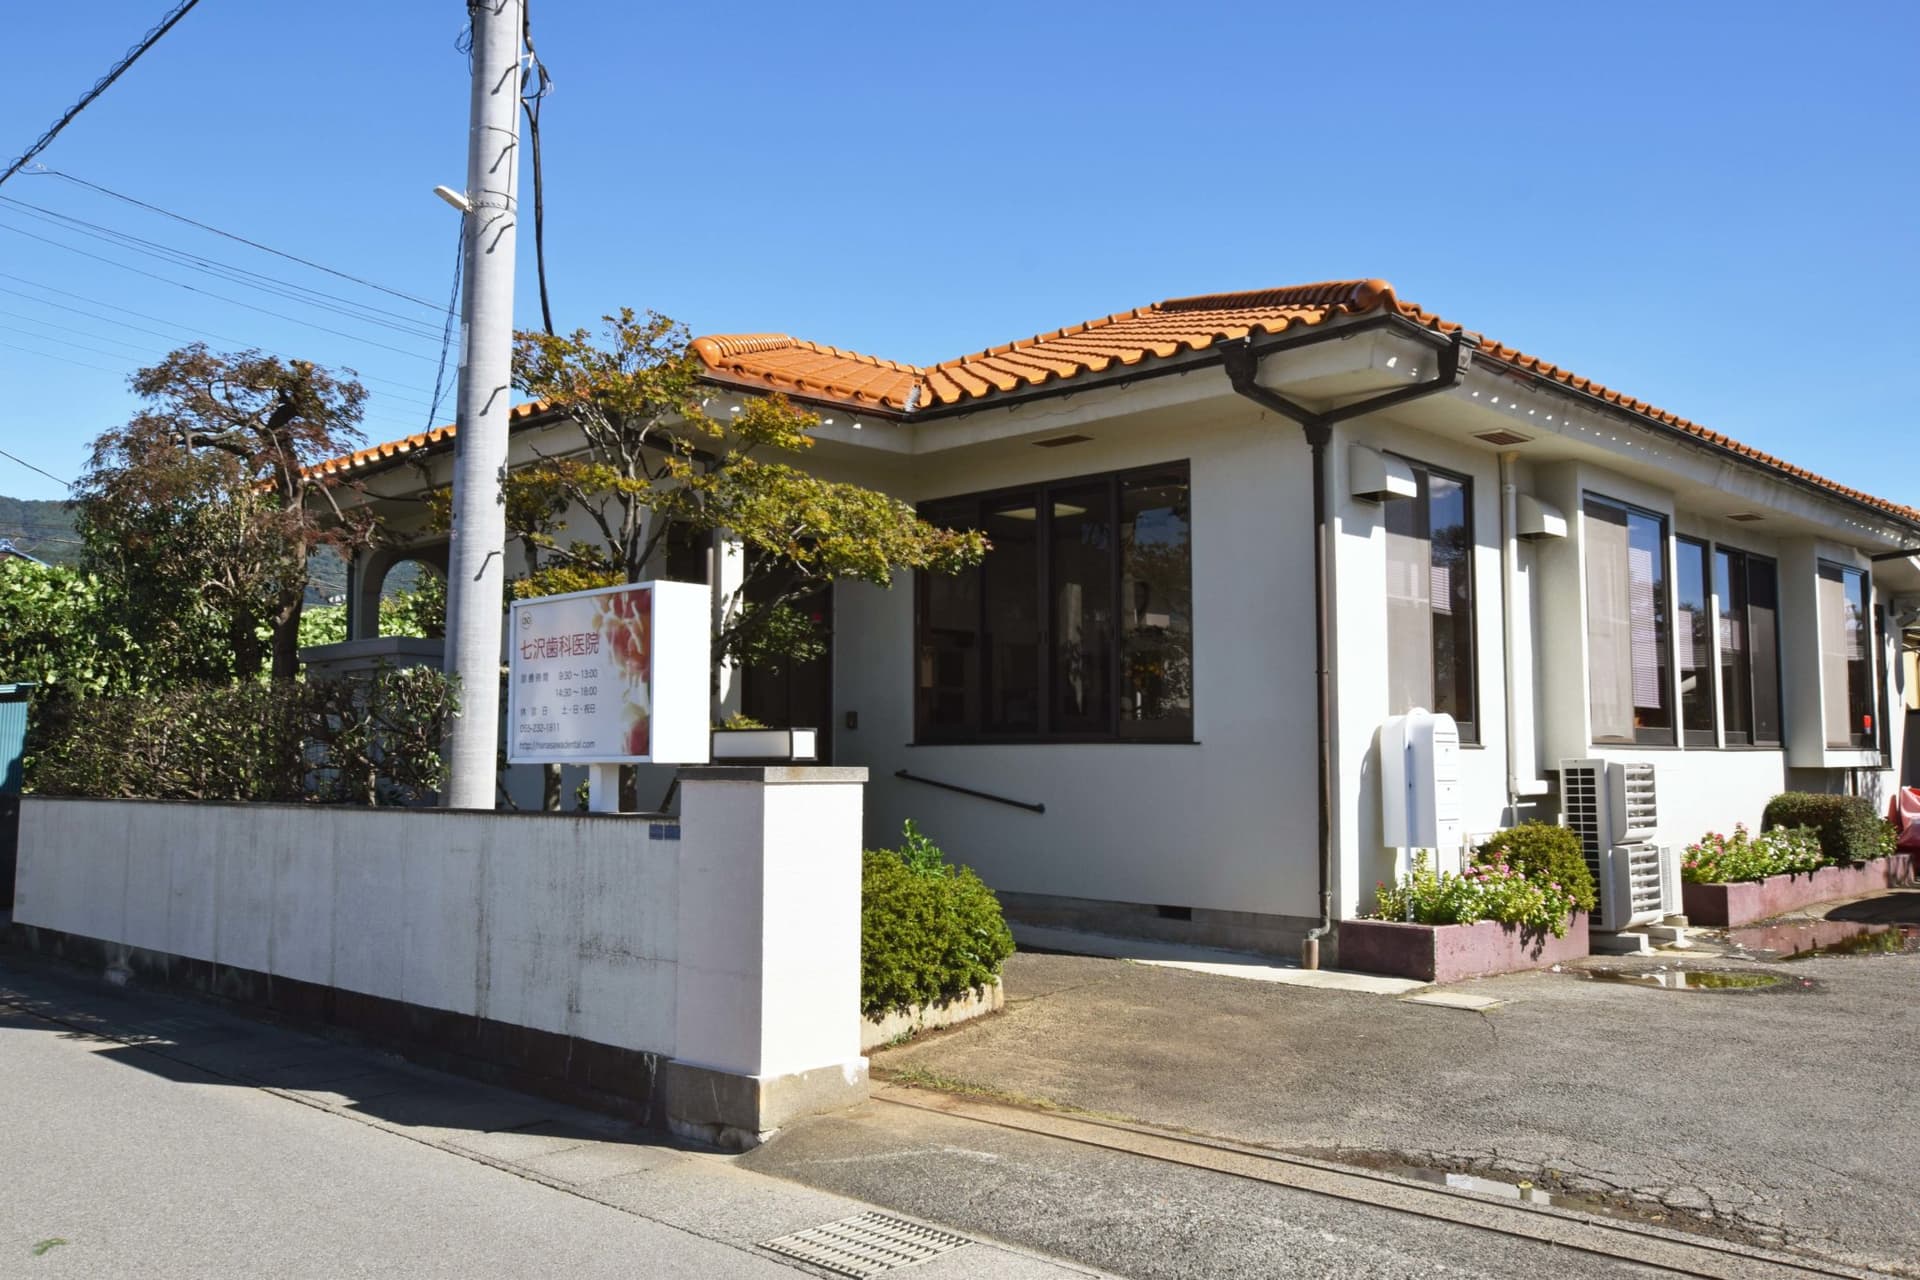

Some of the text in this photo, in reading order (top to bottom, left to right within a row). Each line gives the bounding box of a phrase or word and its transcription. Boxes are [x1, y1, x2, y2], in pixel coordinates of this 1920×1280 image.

[520, 632, 599, 660] 七沢歯科医院
